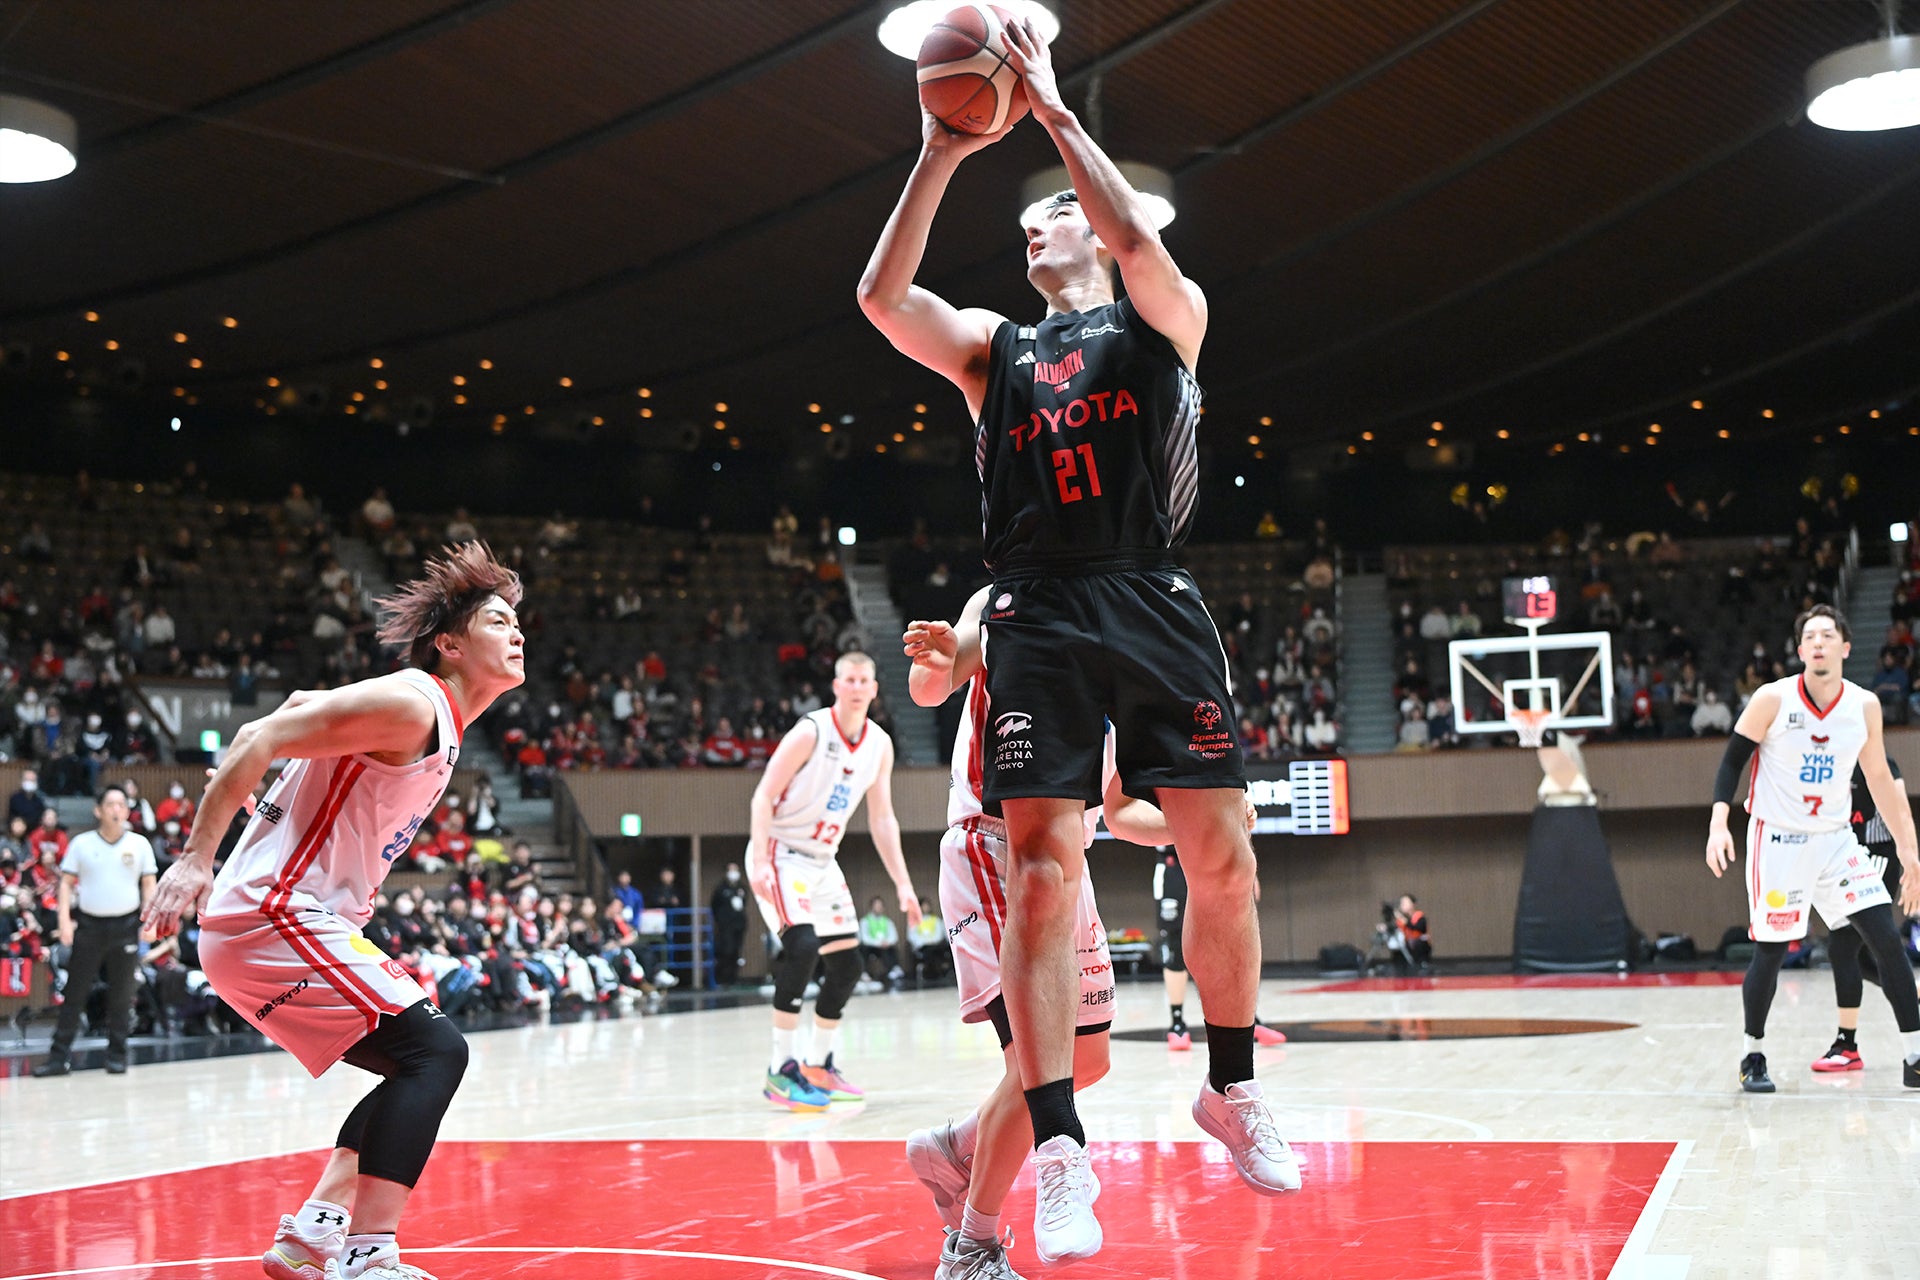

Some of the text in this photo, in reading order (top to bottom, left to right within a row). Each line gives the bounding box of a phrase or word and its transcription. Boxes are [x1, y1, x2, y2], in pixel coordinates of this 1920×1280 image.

[1034, 348, 1085, 384] ALVARK
[1052, 443, 1102, 504] 21
[1527, 590, 1556, 618] 13
[1192, 732, 1228, 742] Special
[997, 741, 1033, 753] TOYOTA
[1188, 742, 1233, 752] Olympics
[994, 750, 1033, 764] ARENA
[1802, 753, 1834, 766] YKK
[997, 761, 1024, 771] TOKYO
[1800, 766, 1833, 784] ap
[1803, 795, 1823, 816] 7
[810, 820, 839, 845] 12
